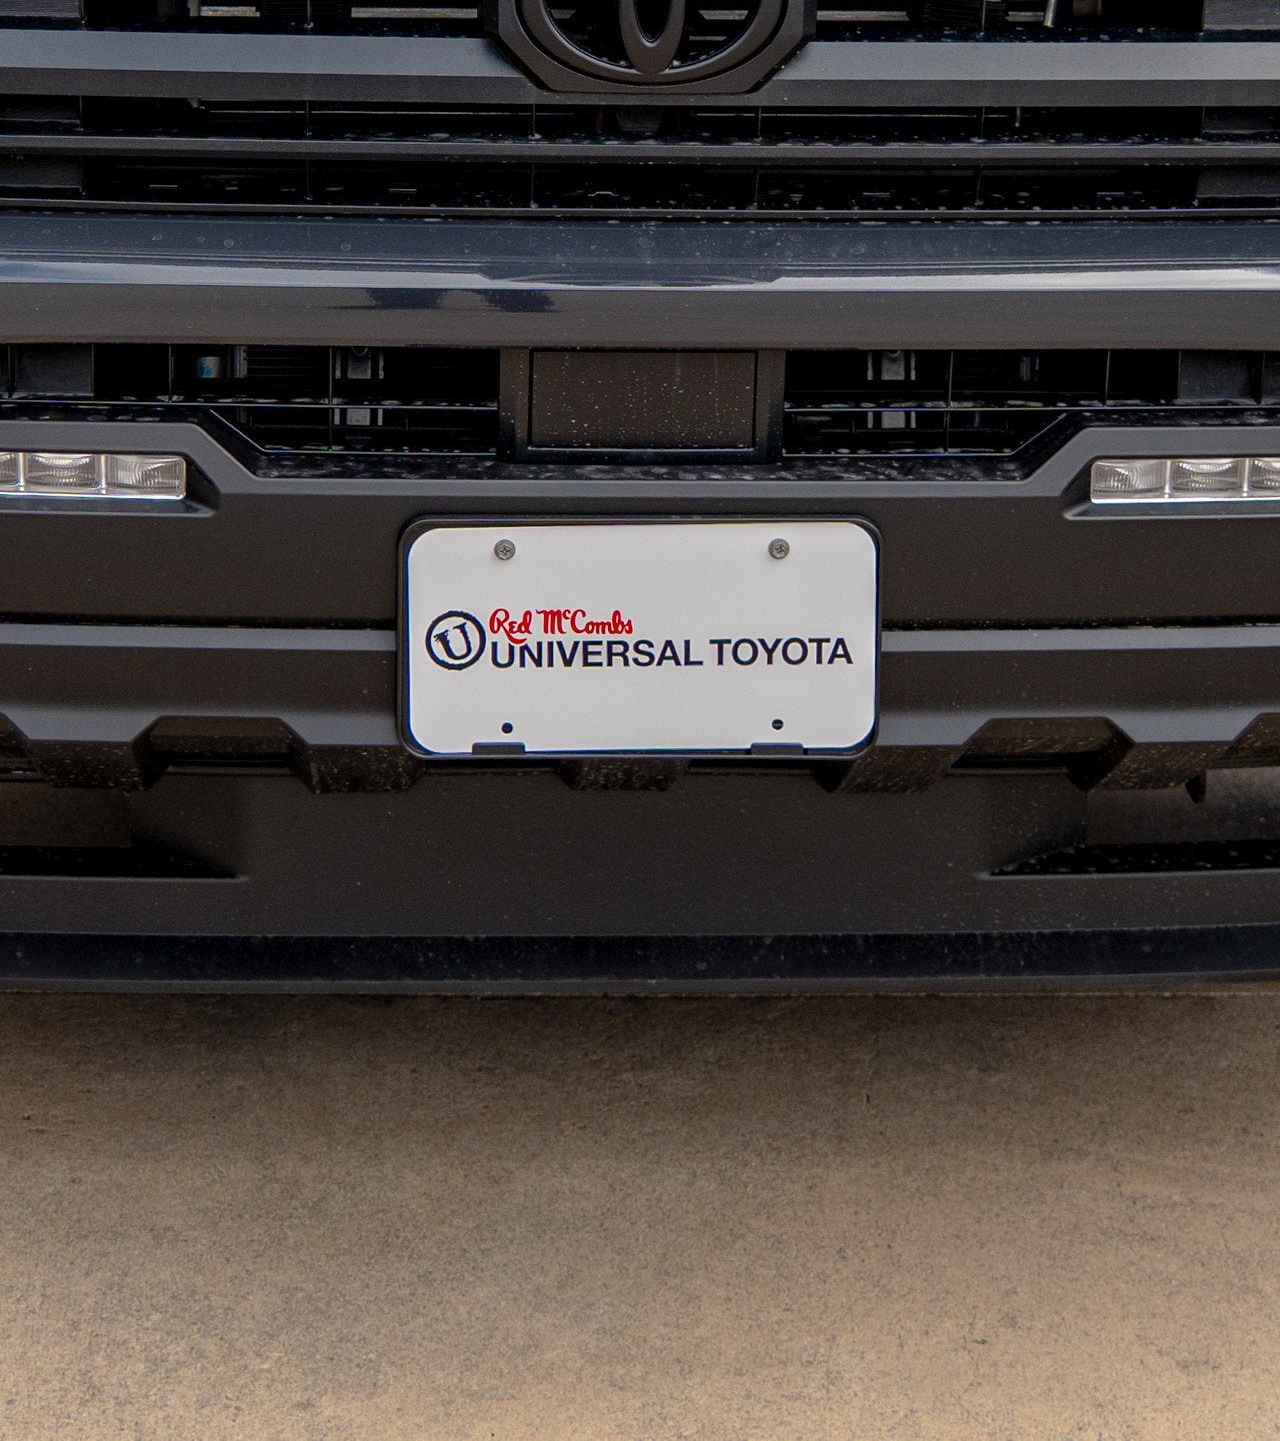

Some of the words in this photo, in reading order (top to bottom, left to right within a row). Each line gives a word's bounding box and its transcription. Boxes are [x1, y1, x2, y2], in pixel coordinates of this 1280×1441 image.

[488, 608, 533, 645] Red
[535, 608, 634, 635] McCombs
[490, 637, 704, 670] UNIVERSAL
[709, 635, 854, 667] TOYOTA
